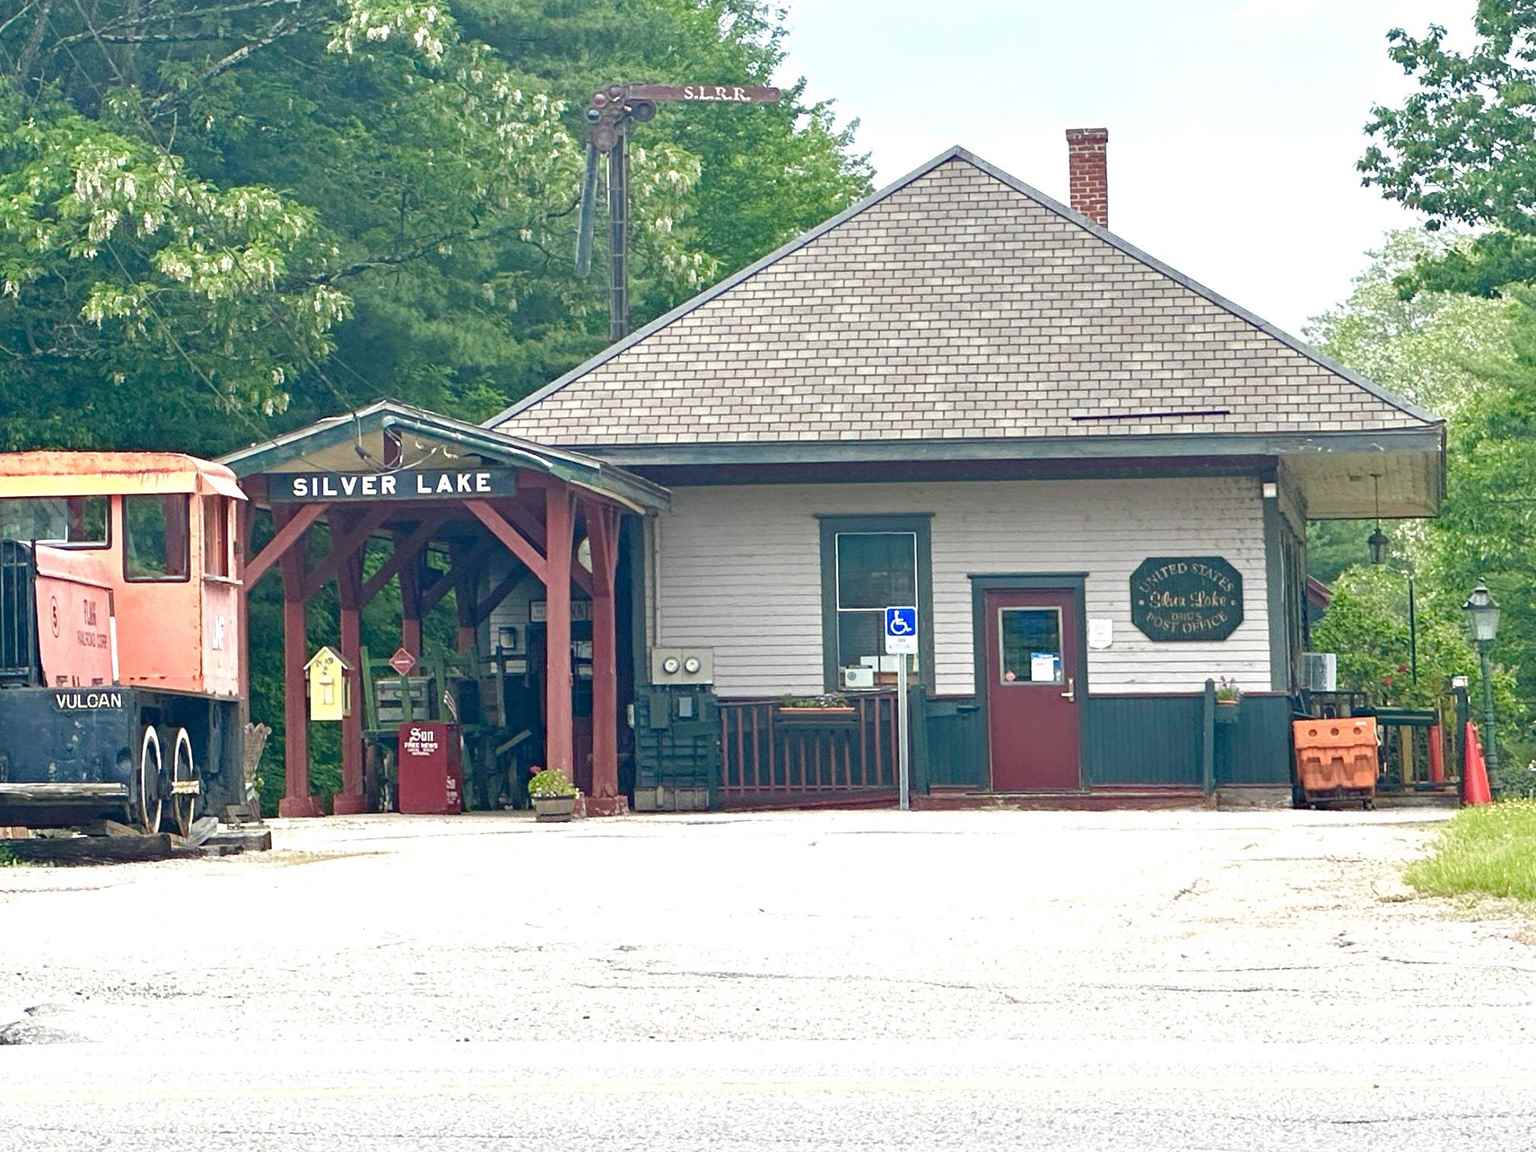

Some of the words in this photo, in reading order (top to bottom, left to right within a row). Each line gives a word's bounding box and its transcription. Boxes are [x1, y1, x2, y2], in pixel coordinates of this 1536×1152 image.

[293, 474, 397, 496] SILVER
[416, 473, 492, 494] LAKE
[1139, 563, 1187, 592] UNITED
[1191, 563, 1234, 592] STATES
[1190, 591, 1227, 608] Lake
[1146, 612, 1180, 632] POST
[1182, 611, 1228, 633] OFFICE
[56, 693, 122, 709] VULCAN
[409, 728, 434, 743] Sun
